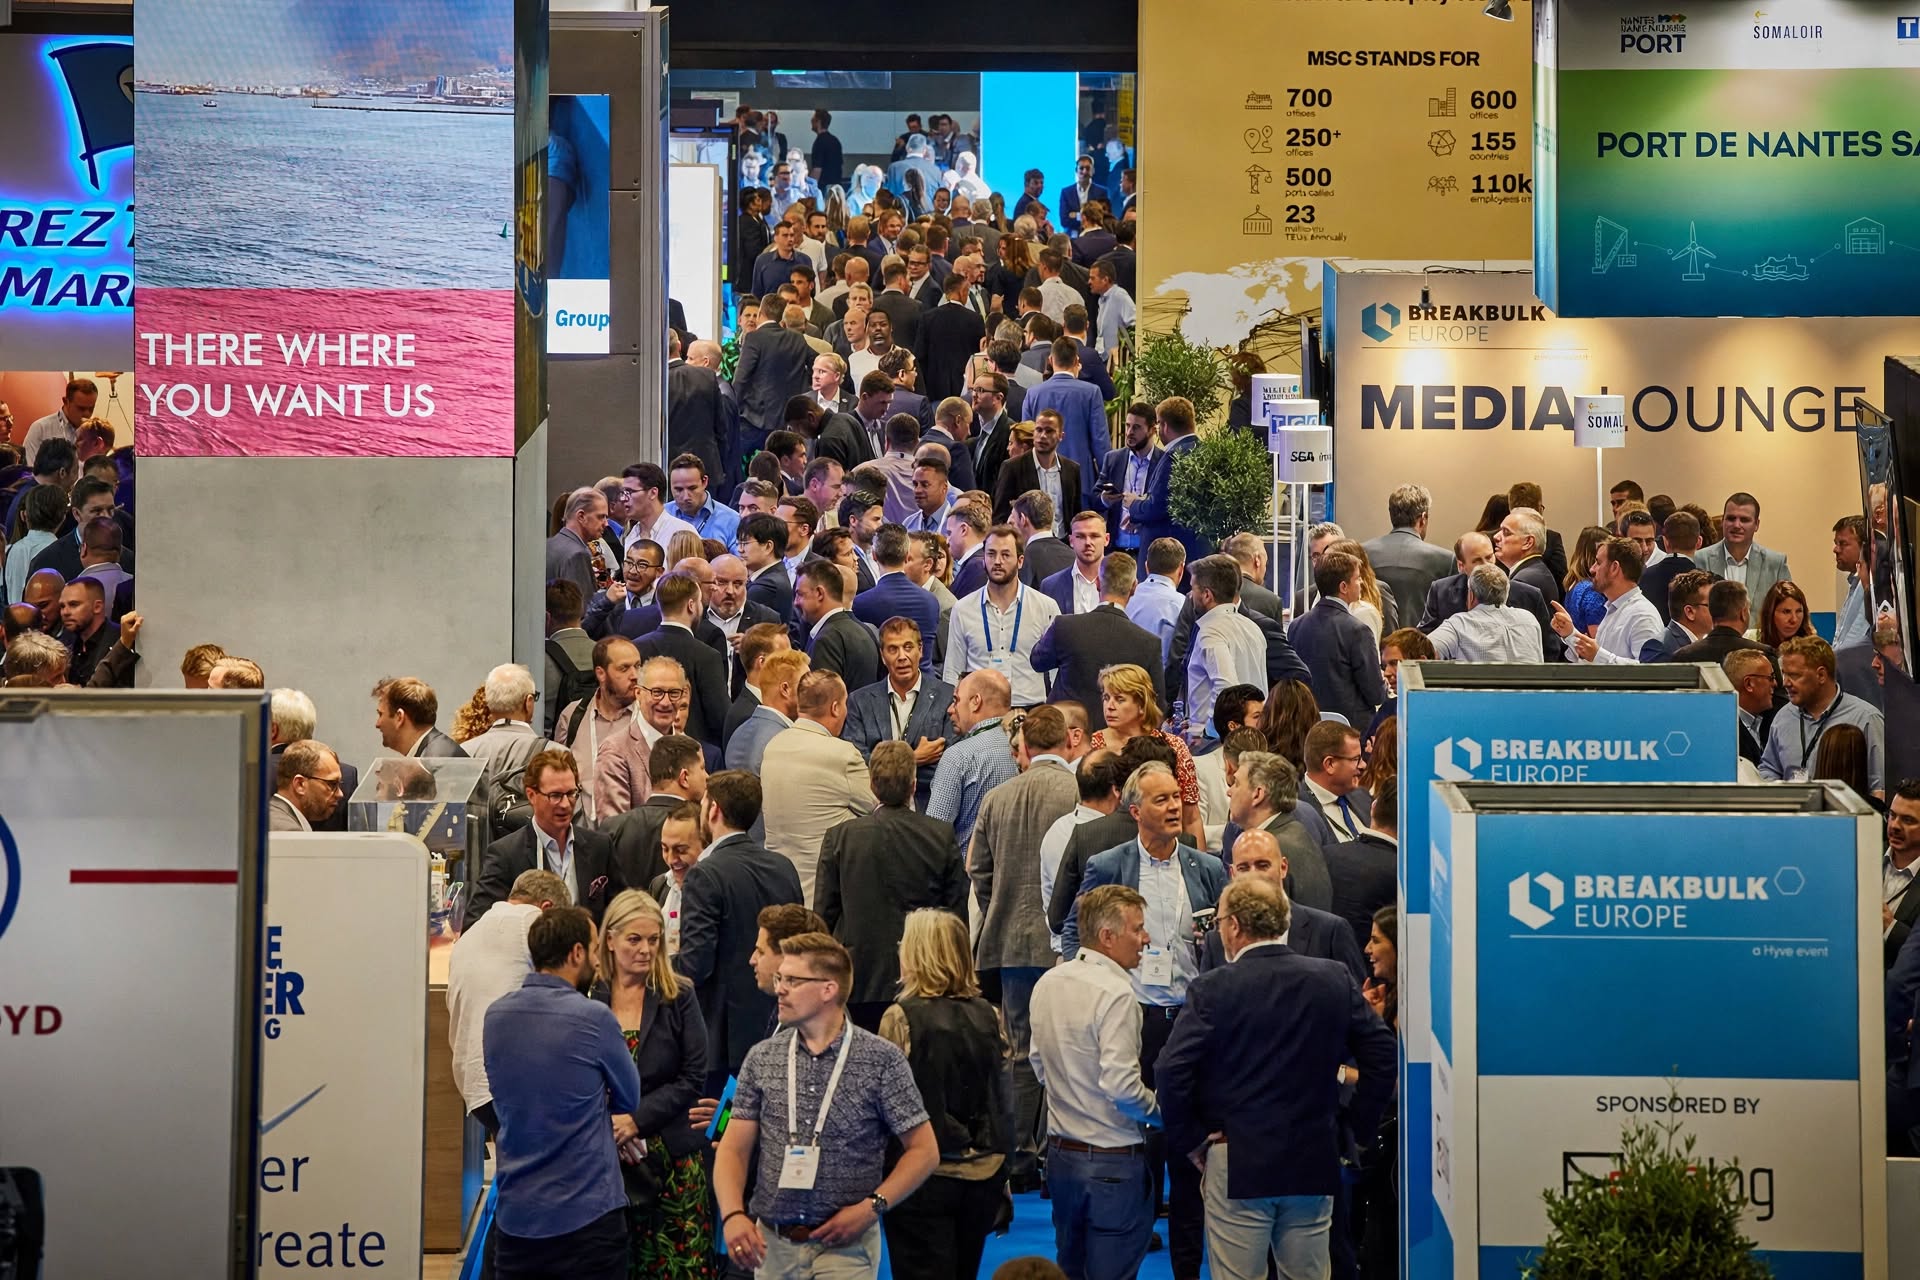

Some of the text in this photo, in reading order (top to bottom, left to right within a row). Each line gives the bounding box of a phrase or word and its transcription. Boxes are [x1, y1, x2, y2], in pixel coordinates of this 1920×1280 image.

[1753, 25, 1823, 39] SOMALOIR
[1620, 33, 1686, 54] PORT
[1307, 50, 1480, 66] MSC STANDS FOR
[1286, 88, 1333, 108] 700
[1471, 90, 1517, 110] 600
[1286, 128, 1342, 147] 250+
[1471, 131, 1517, 151] 155
[1597, 131, 1687, 158] PORT
[1696, 131, 1737, 158] DE
[1748, 130, 1882, 158] NANTES
[1285, 167, 1332, 187] 500
[1472, 173, 1532, 194] 110k
[1285, 205, 1316, 224] 23
[555, 309, 610, 332] Group
[1408, 305, 1546, 321] BREAKBULK
[1408, 325, 1489, 342] EUROPE
[140, 333, 416, 367] THERE WHERE
[140, 383, 436, 418] YOU WANT US
[1361, 384, 1575, 431] MEDIA
[1601, 385, 1866, 433] OUNGE
[1587, 414, 1625, 428] SOMAL
[1490, 739, 1660, 761] BREAKBULK
[1574, 875, 1769, 900] BREAKBULK
[1574, 904, 1688, 929] EUROPE
[1796, 946, 1829, 957] event
[0, 1004, 63, 1036] YD
[1596, 1096, 1761, 1115] SPONSORED BY
